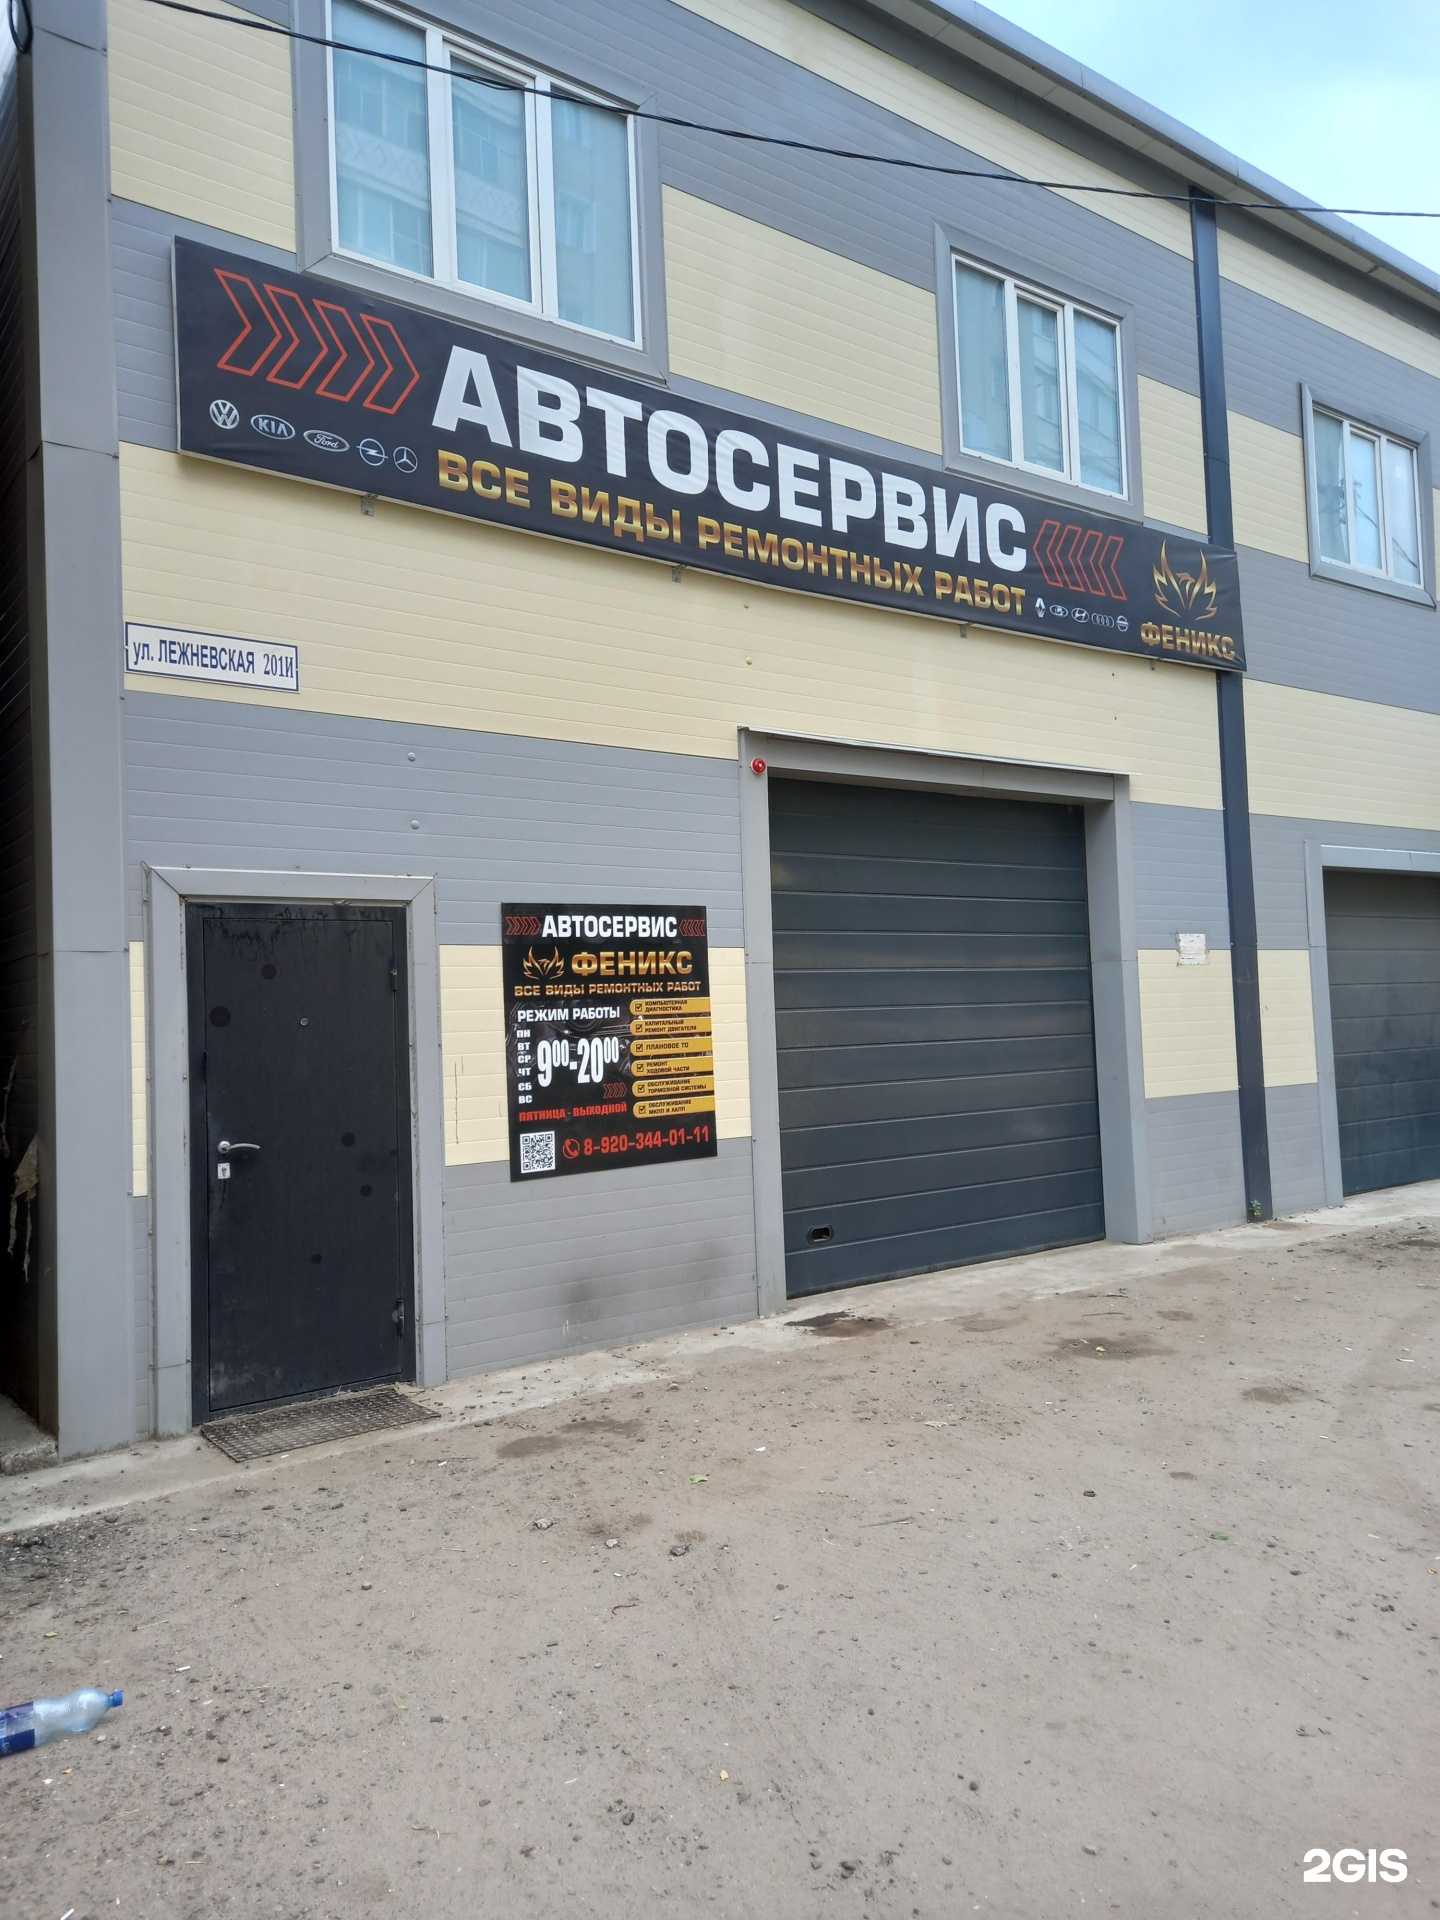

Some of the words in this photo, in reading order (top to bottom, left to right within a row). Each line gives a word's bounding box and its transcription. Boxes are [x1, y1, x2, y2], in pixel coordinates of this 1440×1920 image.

[432, 345, 1027, 572] АВТОСЕРВИС
[438, 449, 530, 509] ВСЕ
[550, 479, 681, 544] ВИДЫ
[697, 515, 925, 596] РЕМОНТНЫХ
[935, 570, 1026, 616] РАБОТ
[1140, 622, 1235, 660] ФЕНИКС
[133, 641, 154, 665] ул.
[158, 639, 255, 674] ЛЕЖНЕВСКАЯ
[263, 653, 294, 679] 201И
[541, 915, 678, 938] АВТОСЕРВИС
[571, 951, 693, 977] ФЕНИКС
[514, 985, 541, 997] ВСЕ
[545, 983, 585, 998] ВИДЫ
[588, 982, 664, 995] РЕМОНТНЫХ
[667, 981, 702, 993] РАБОТ
[517, 1009, 569, 1022] РЕЖИМ
[573, 1006, 621, 1020] РАБОТЫ
[516, 1029, 531, 1038] ПН
[518, 1042, 530, 1051] ВТ
[646, 1042, 680, 1050] ПЛАНОВОЕ
[518, 1055, 532, 1063] СР
[518, 1068, 532, 1076] ЧТ
[518, 1082, 532, 1091] СБ
[518, 1095, 533, 1104] ВС
[518, 1108, 566, 1121] ПЯТНИЦА
[572, 1102, 628, 1117] ВЫХОДНОЙ
[583, 1125, 710, 1157] 8-920-344-01-11
